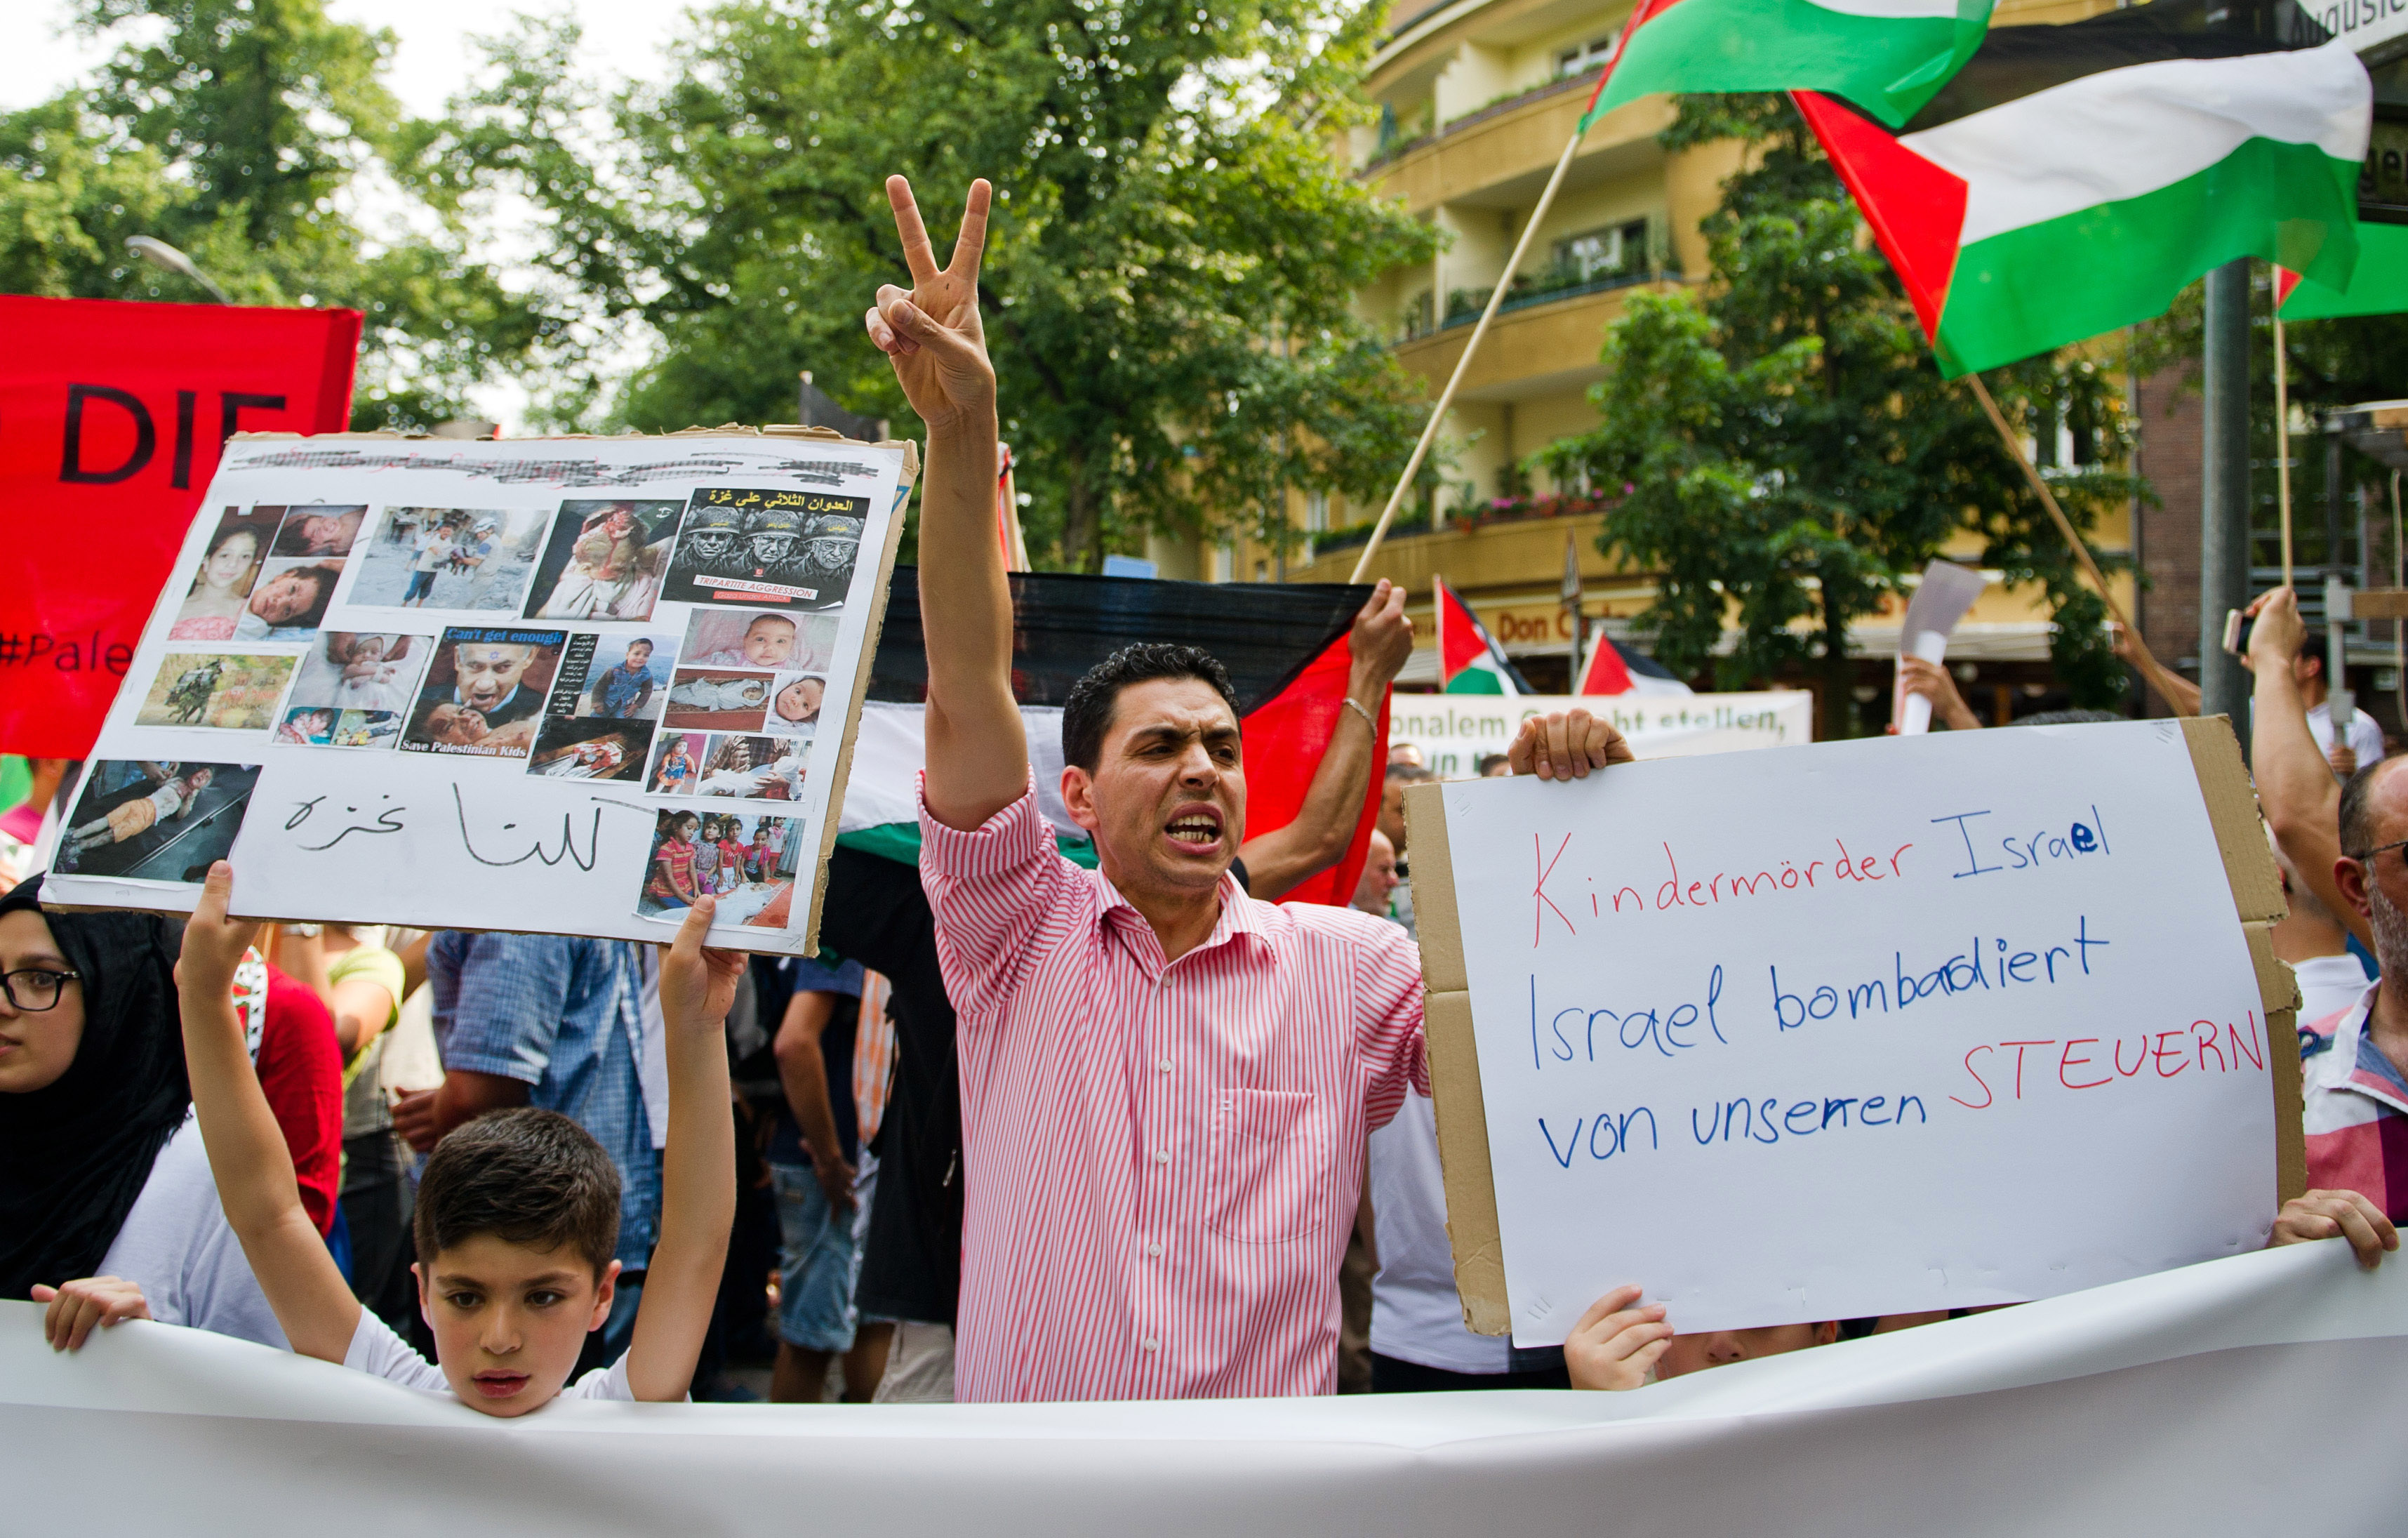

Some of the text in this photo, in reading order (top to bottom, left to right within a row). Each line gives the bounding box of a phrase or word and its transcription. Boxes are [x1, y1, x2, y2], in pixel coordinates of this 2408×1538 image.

[709, 490, 853, 512] العدوان الثلاثي على غزة
[699, 577, 813, 597] TRIPARTITE AGGRESSION
[446, 628, 563, 645] Can't get enough
[1496, 611, 1548, 643] Don
[401, 739, 527, 757] Save Palestinian Kids
[1533, 804, 2110, 949] Kindermörder Israel
[1531, 964, 1729, 1071] Israel
[1538, 1106, 1658, 1169] von
[1948, 1010, 2265, 1110] STEUERN
